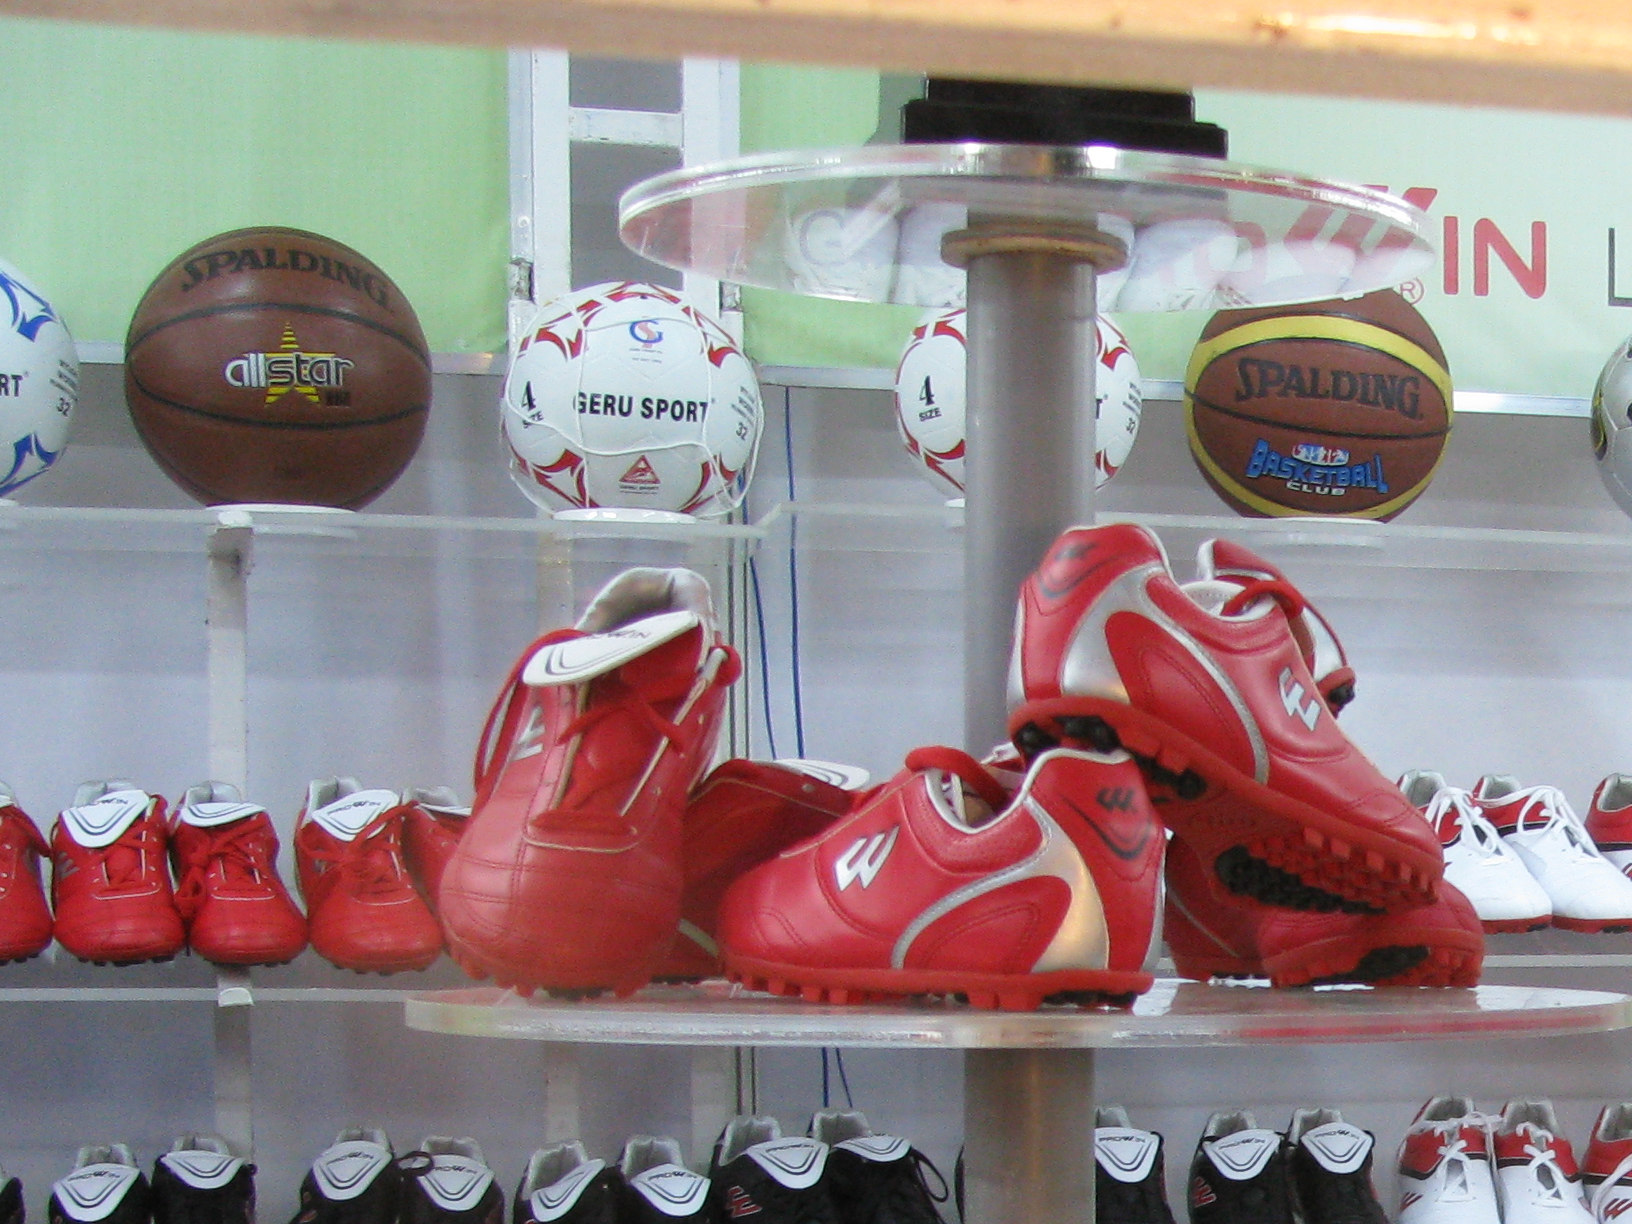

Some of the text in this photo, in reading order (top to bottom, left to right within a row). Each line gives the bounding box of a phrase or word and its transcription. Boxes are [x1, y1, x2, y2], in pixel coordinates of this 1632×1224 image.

[182, 248, 389, 306] SPALDING
[919, 375, 936, 407] 4
[1235, 356, 1425, 422] SPALDING
[574, 391, 634, 418] GERU
[640, 397, 709, 424] SPORT
[918, 407, 943, 422] SIZE
[1285, 479, 1347, 497] CLUB
